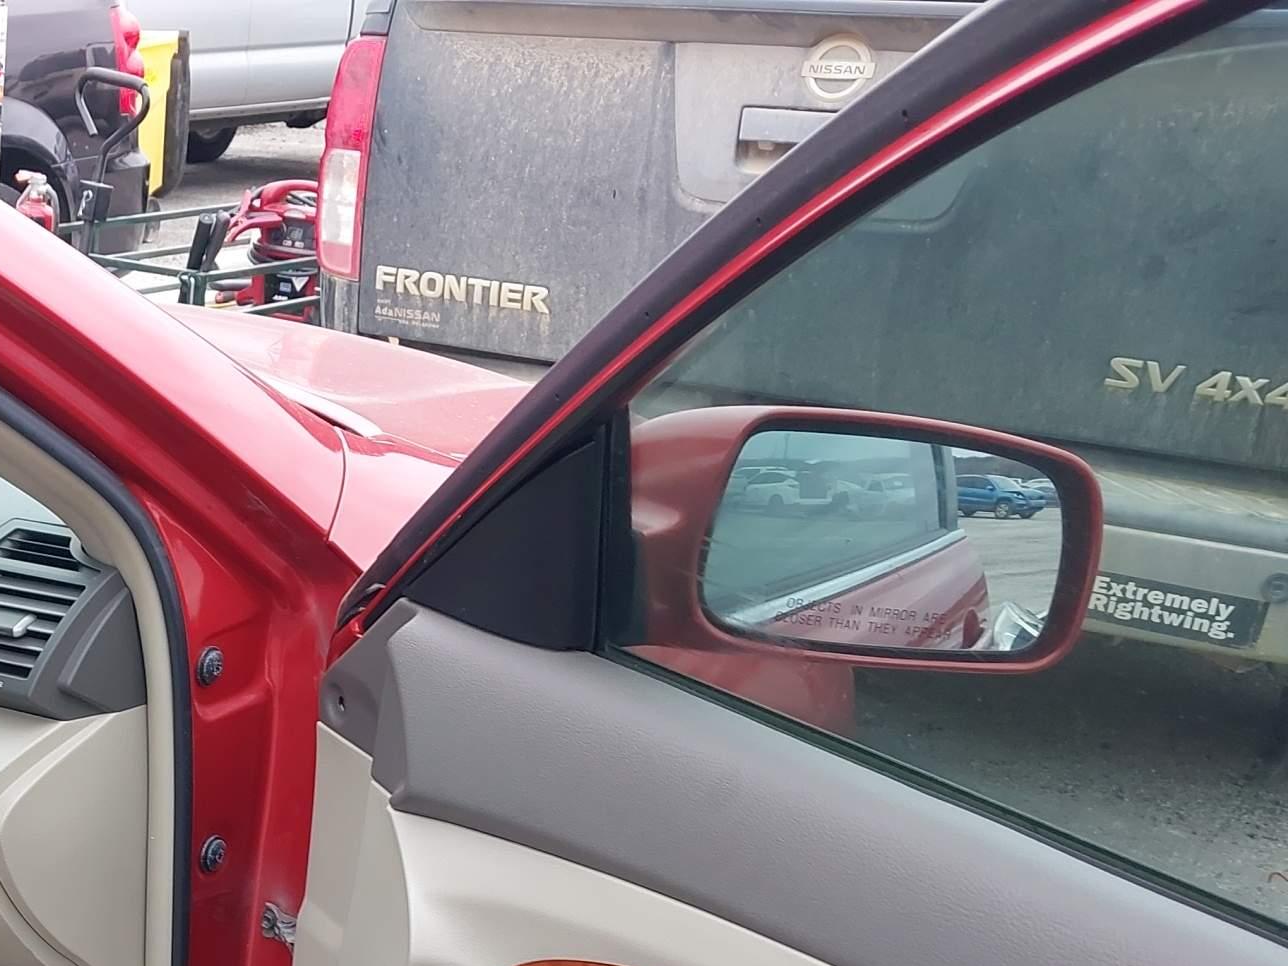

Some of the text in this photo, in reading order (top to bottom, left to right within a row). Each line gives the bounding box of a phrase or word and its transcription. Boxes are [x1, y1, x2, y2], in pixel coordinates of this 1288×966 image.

[808, 64, 866, 75] NISSAN
[375, 265, 550, 314] FRONTIER
[1104, 357, 1187, 393] SV
[850, 605, 863, 615] IN
[870, 606, 916, 621] MIRROR
[924, 611, 947, 625] ARE
[1087, 593, 1235, 640] Rightwing.
[1092, 575, 1235, 622] Extremely
[775, 611, 953, 640] CLOSER THAN THEY APPEAR
